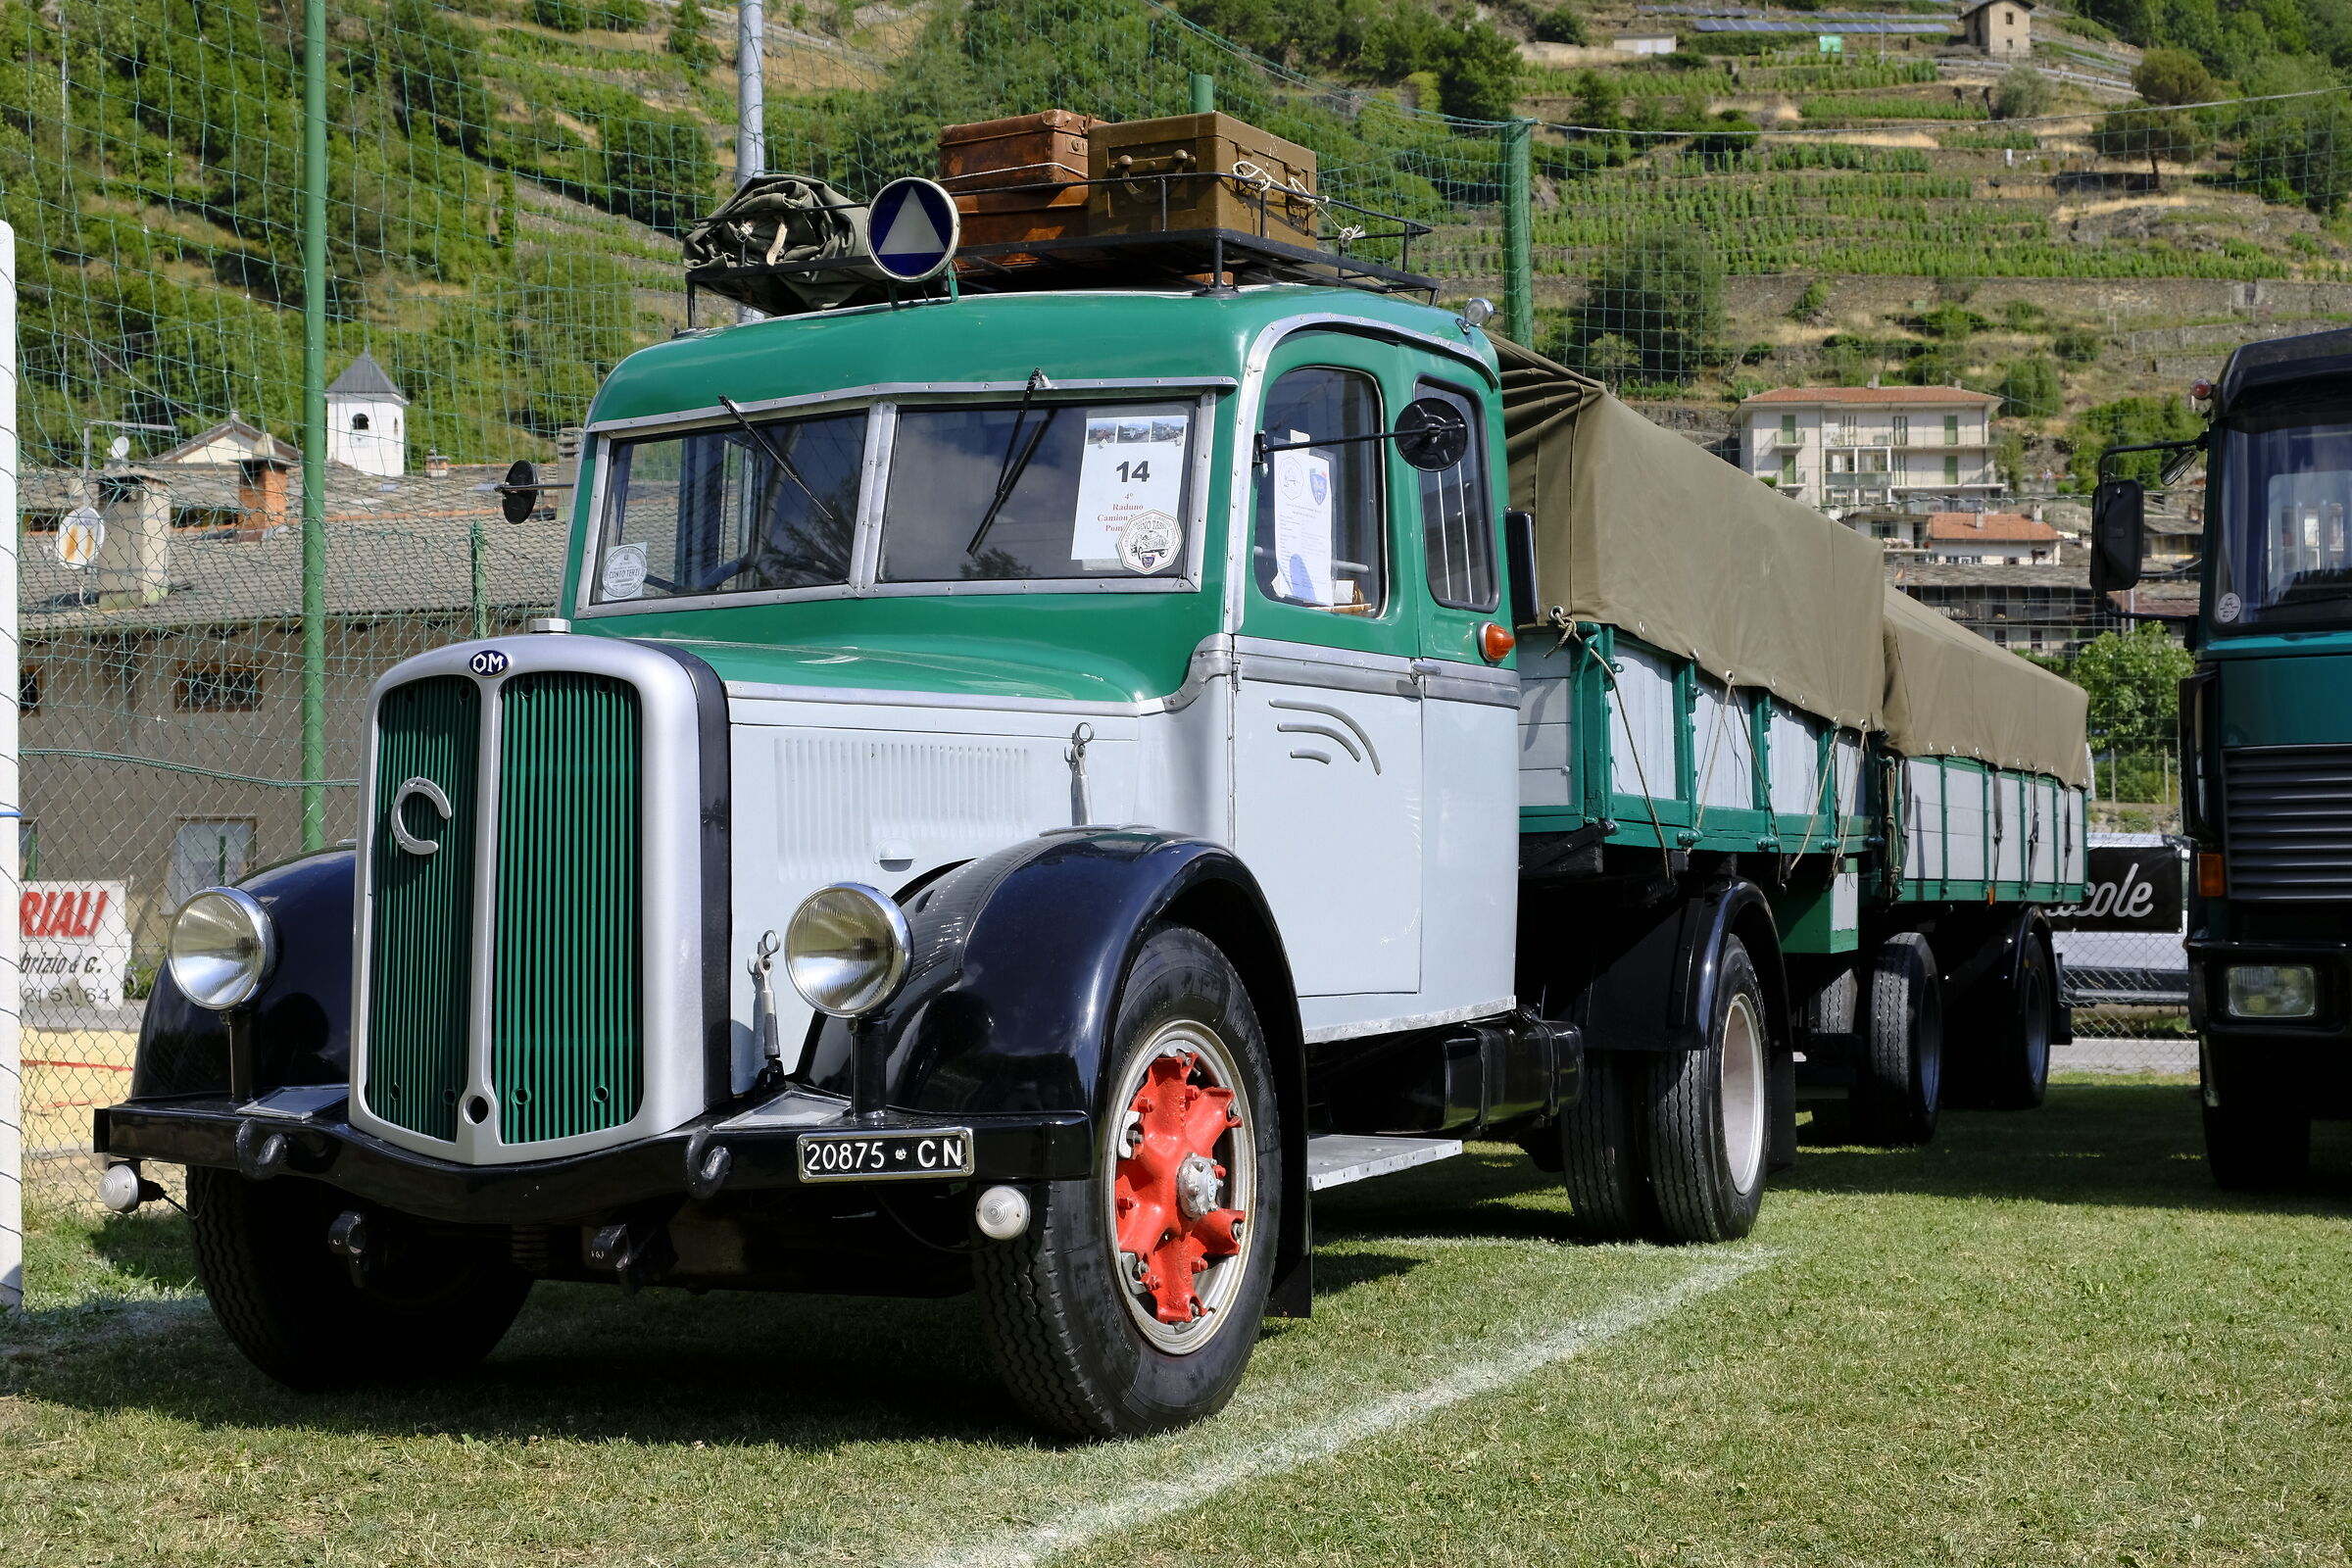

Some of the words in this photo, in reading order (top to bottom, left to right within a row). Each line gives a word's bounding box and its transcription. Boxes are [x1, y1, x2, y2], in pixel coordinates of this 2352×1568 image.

[1116, 461, 1150, 482] 14
[473, 653, 504, 672] OM
[806, 1141, 886, 1171] 20875
[916, 1139, 963, 1168] CN
